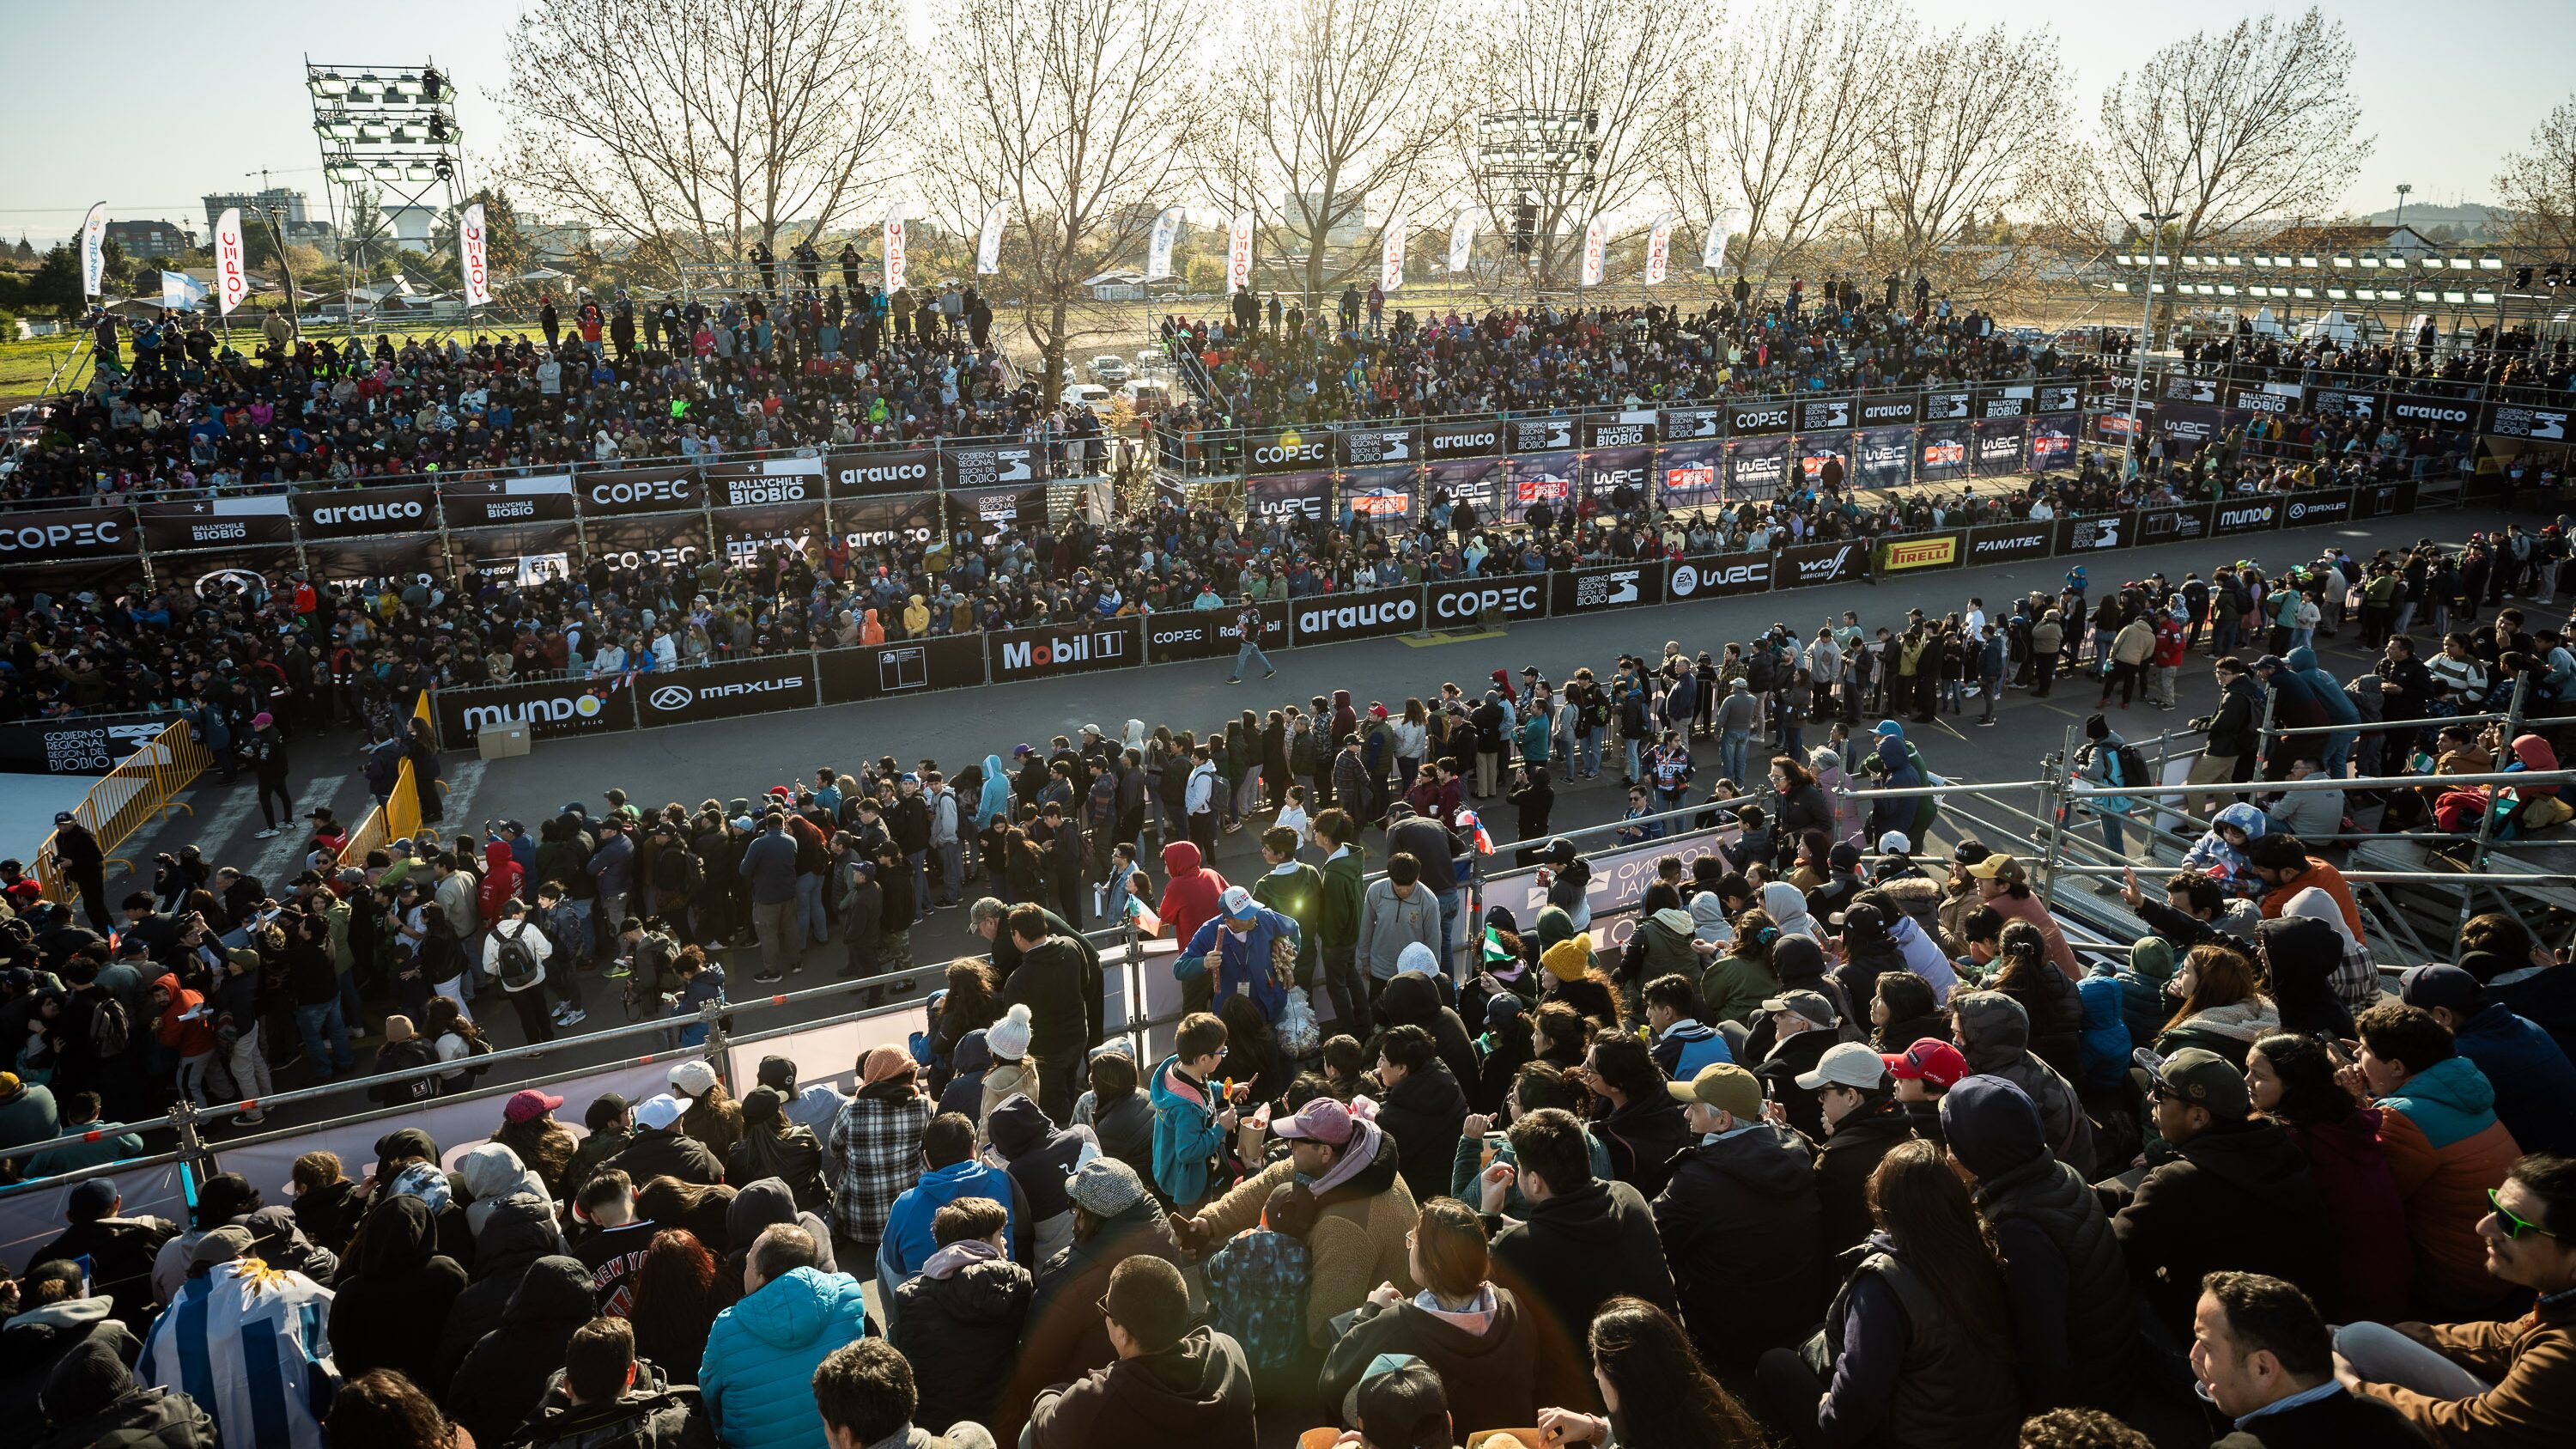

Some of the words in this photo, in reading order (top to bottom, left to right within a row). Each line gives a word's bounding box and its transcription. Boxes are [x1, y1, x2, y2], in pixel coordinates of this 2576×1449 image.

[890, 223, 901, 286] COPEC
[1234, 228, 1249, 286] COPEC
[1388, 232, 1401, 285] COPEC
[1589, 228, 1603, 279] COPEC
[1652, 228, 1666, 279] COPEC
[222, 232, 241, 305] COPEC
[466, 228, 483, 297] COPEC
[1988, 399, 2022, 407] RALLYCHILE
[2239, 393, 2287, 403] RALLYCHILE
[1865, 404, 1912, 418] arauco
[2397, 405, 2468, 422] arauco
[1736, 411, 1788, 428] COPEC
[2165, 419, 2211, 435] WRC
[1597, 425, 1643, 435] RALLYCHILE
[1433, 432, 1495, 449] arauco
[1982, 435, 2020, 450] WRC
[957, 451, 996, 460] GOBIERNO
[1255, 443, 1324, 464] COPEC
[1865, 446, 1906, 460] WRC
[958, 459, 996, 467] REGIONAL
[1736, 456, 1782, 473] WRC
[840, 465, 927, 484] arauco
[959, 473, 997, 484] BIOBIO
[1594, 468, 1643, 484] WRC
[728, 476, 804, 490] RALLYCHILE
[592, 479, 689, 505] COPEC
[979, 495, 1016, 504] GOBIERNO
[486, 500, 533, 509] RALLYCHILE
[979, 502, 1016, 511] REGIONAL
[1261, 496, 1321, 515] WRC
[2307, 502, 2347, 513] MAXUS
[313, 501, 422, 525] arauco
[191, 522, 245, 532] RALLYCHILE
[726, 527, 810, 541] GRUPO
[0, 521, 120, 551] COPEC
[1976, 535, 2043, 552] FANATEC
[1892, 542, 1950, 564] PIRELLI
[1578, 575, 1609, 583] GOBIERNO
[1677, 572, 1692, 582] EA
[1704, 563, 1769, 587] WRC
[1800, 570, 1829, 580] LUBRICANTS
[1437, 586, 1538, 618] COPEC
[1577, 594, 1607, 606] BIOBIO
[1300, 600, 1416, 633] arauco
[1153, 629, 1202, 643] COPEC
[1003, 636, 1089, 669] Mobil
[701, 676, 803, 700] MAXUS
[44, 728, 105, 741] GOBIERNO
[46, 739, 106, 750] REGIONAL
[48, 750, 85, 759] REGION
[90, 747, 107, 756] DEL
[49, 756, 110, 771] BIOBIO
[592, 1256, 624, 1291] NEW
